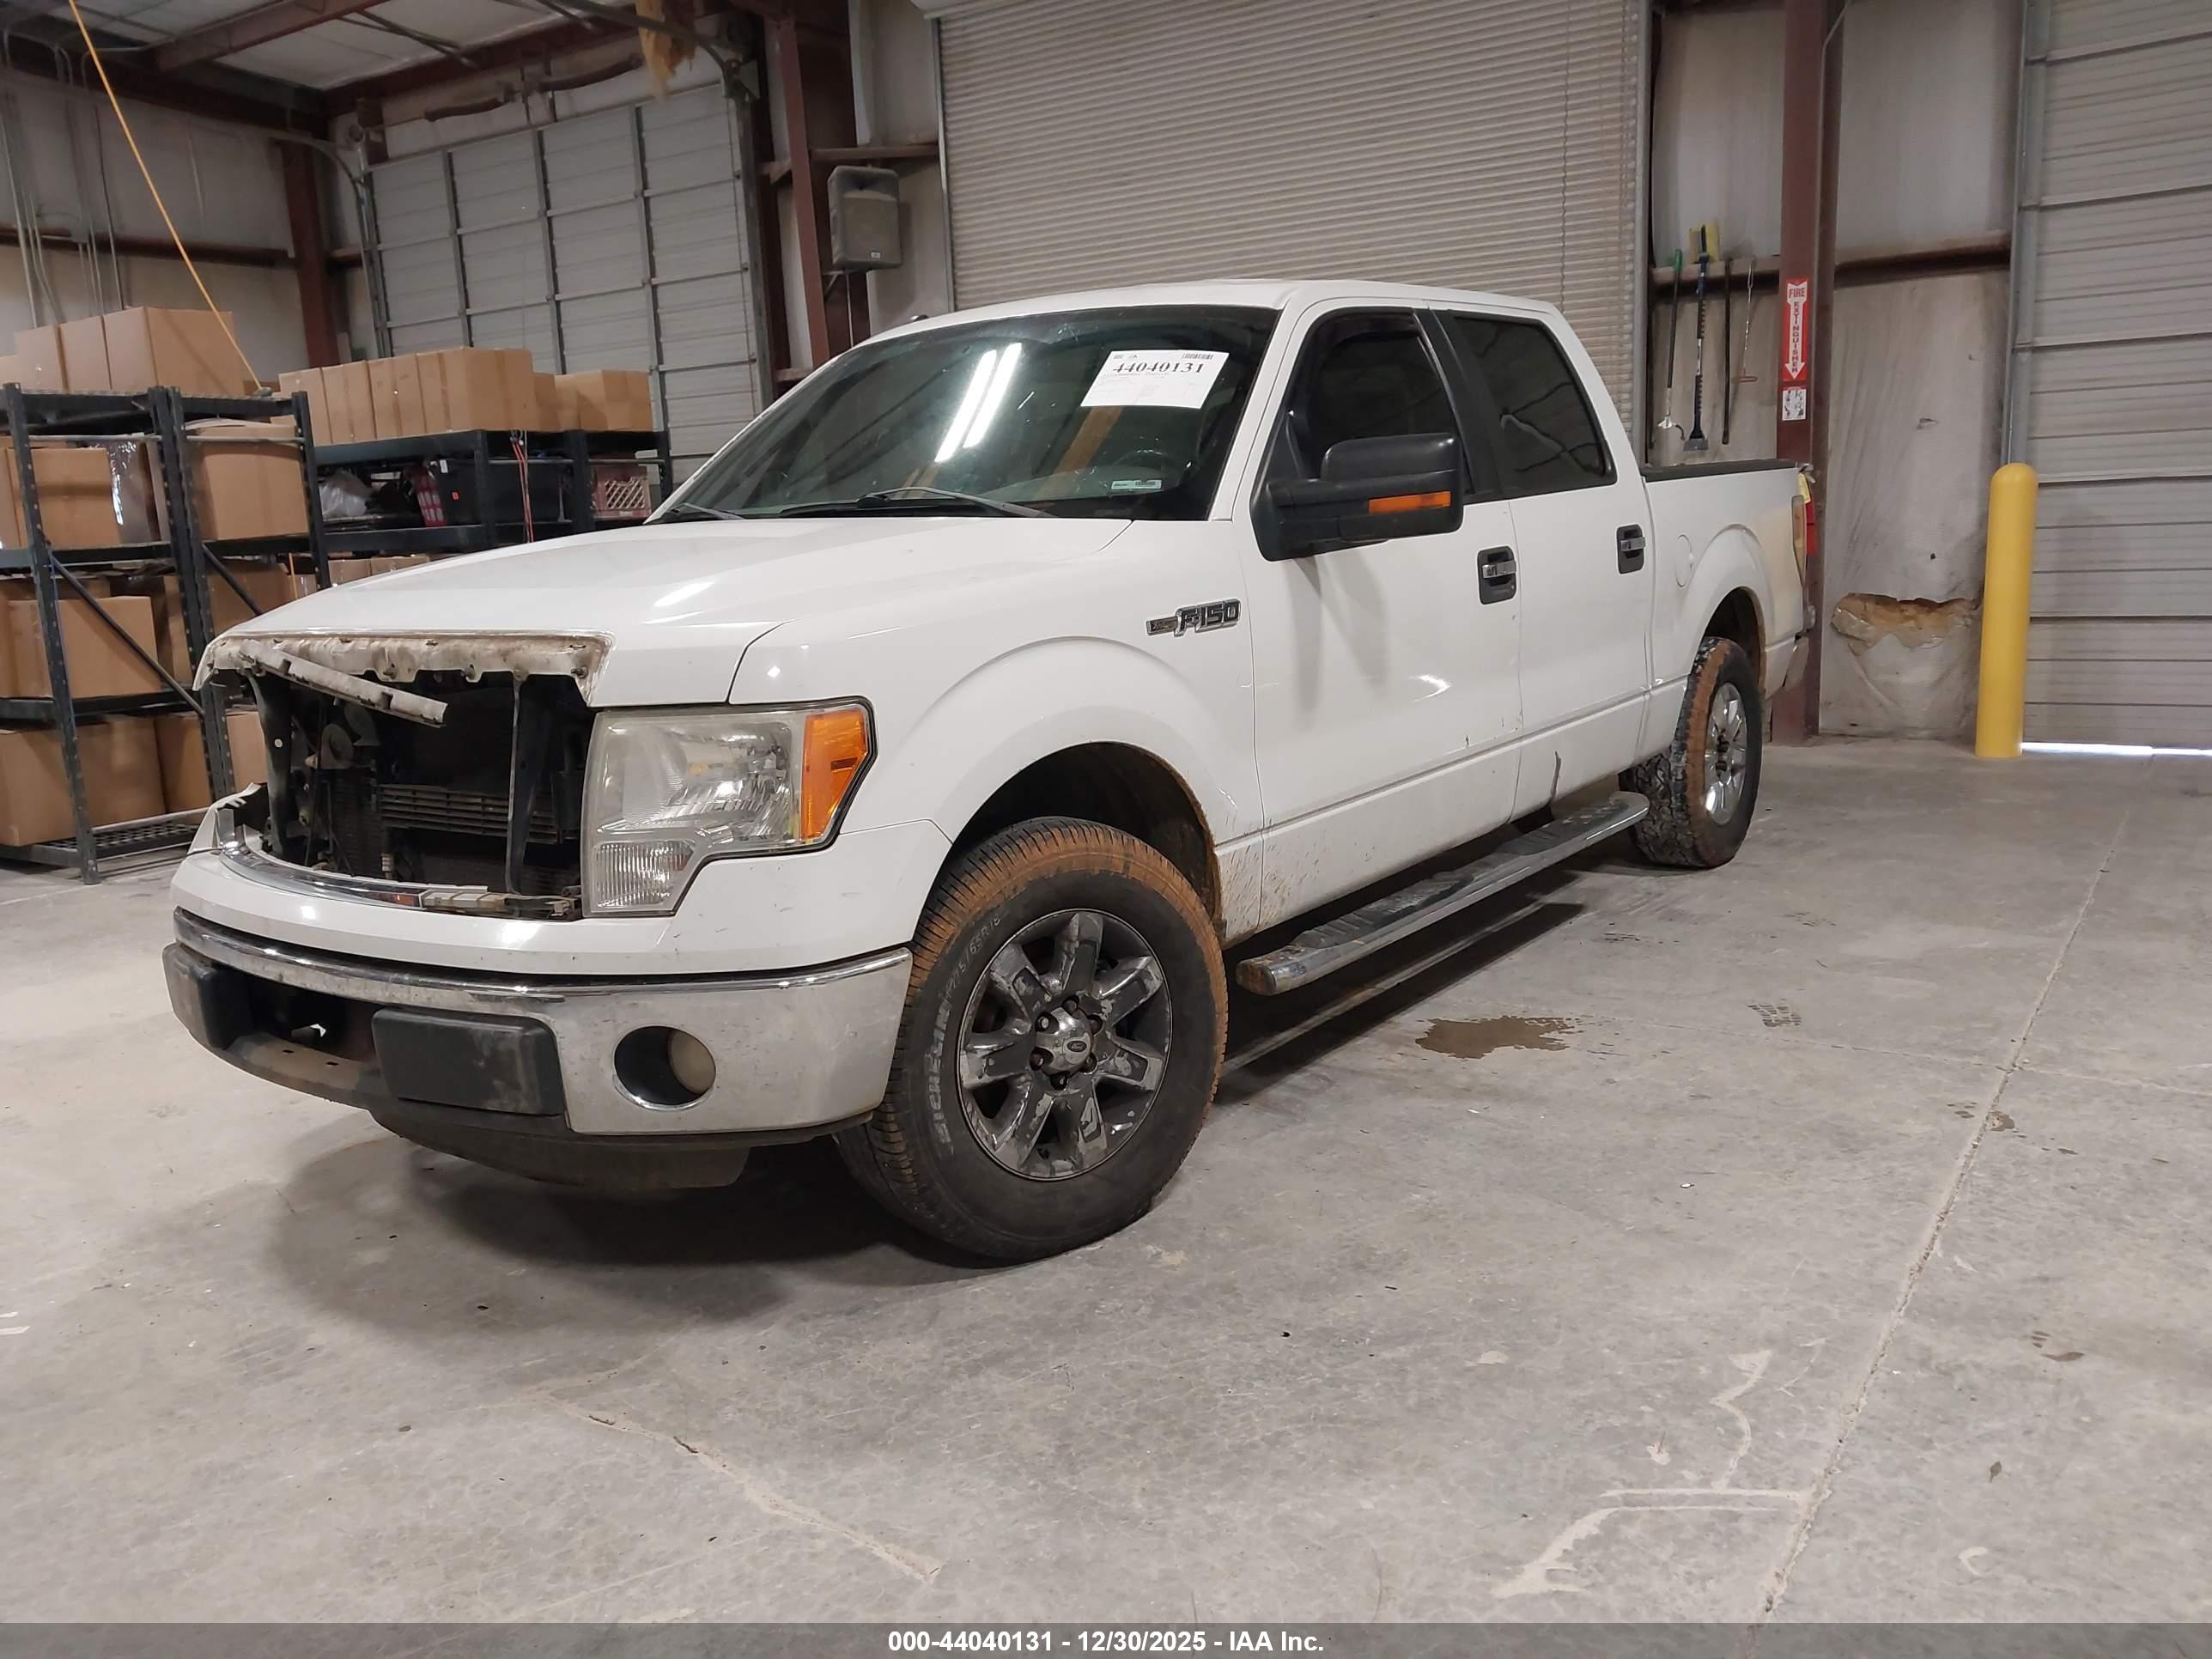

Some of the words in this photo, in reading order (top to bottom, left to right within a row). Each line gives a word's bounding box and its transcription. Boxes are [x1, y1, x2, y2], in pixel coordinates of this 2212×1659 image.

[1789, 288, 1805, 298] FIRE
[1113, 362, 1205, 374] 44040131
[925, 1000, 953, 1144] MICHELIN
